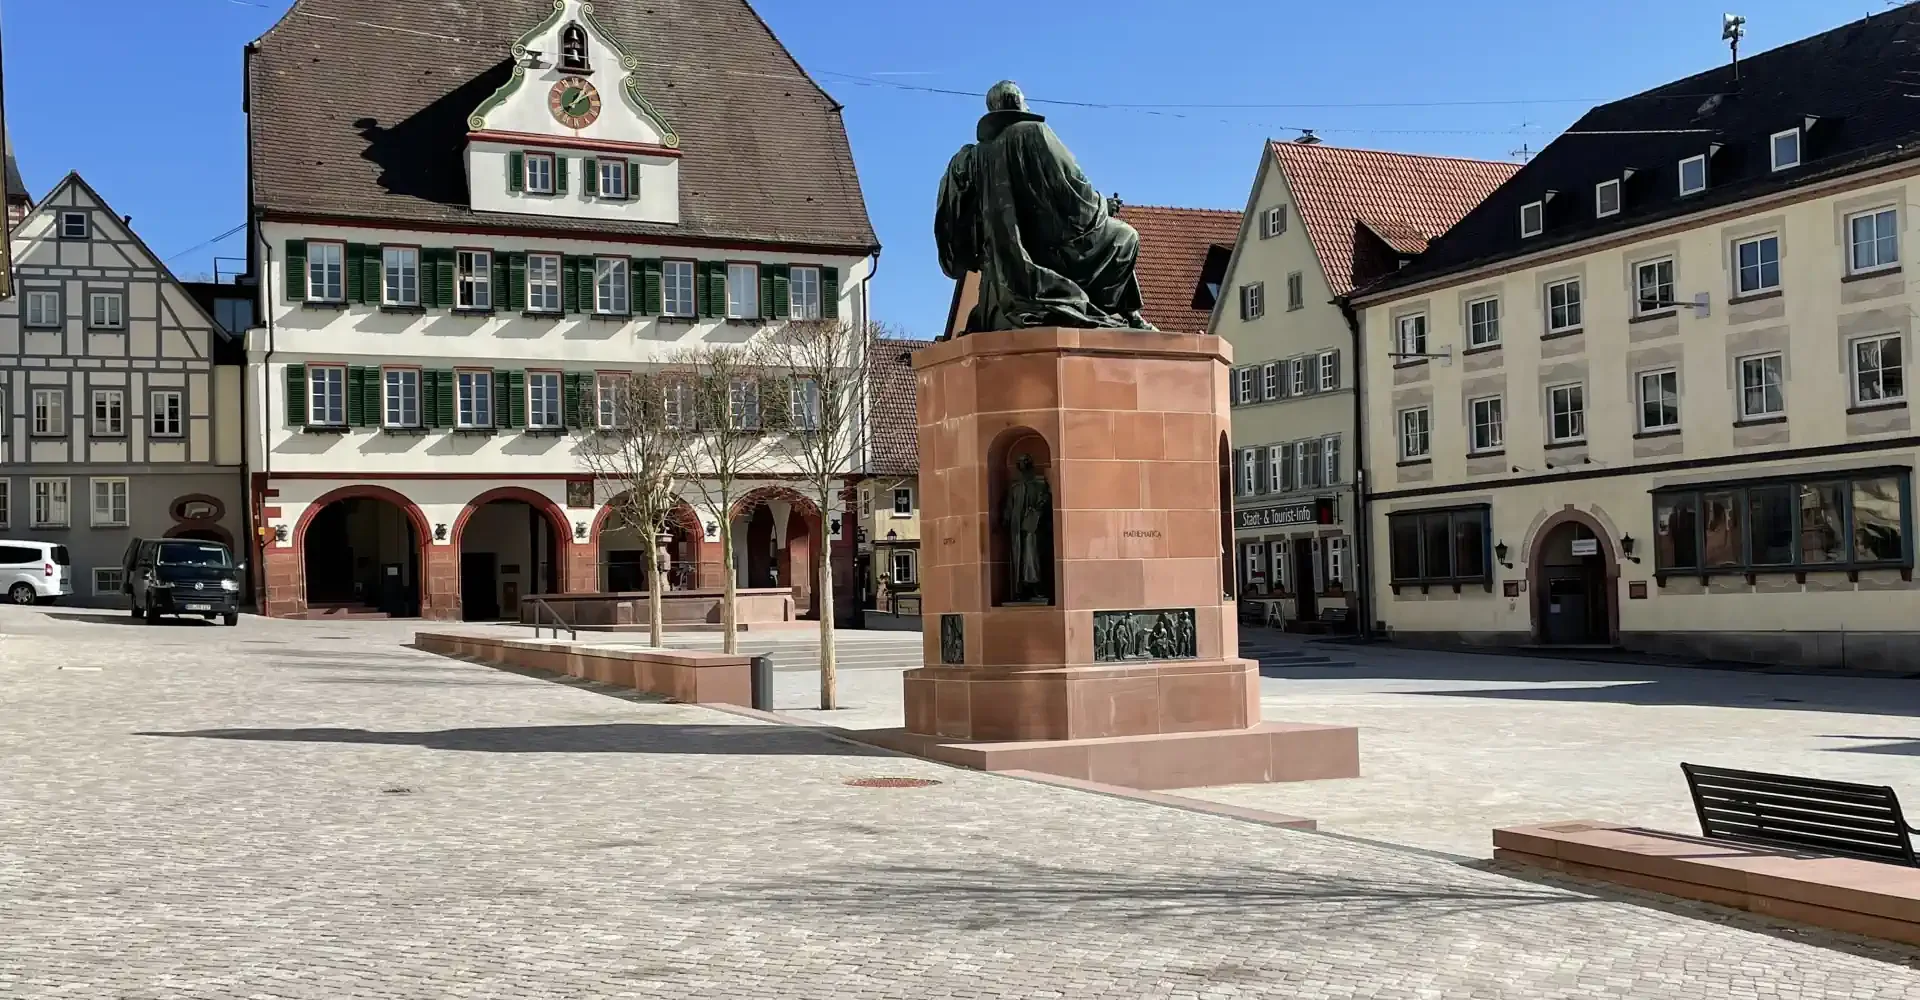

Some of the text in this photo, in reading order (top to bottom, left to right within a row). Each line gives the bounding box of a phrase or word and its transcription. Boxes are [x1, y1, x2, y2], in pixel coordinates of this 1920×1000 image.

[1242, 505, 1311, 527] Stadt- & Tourist-Info
